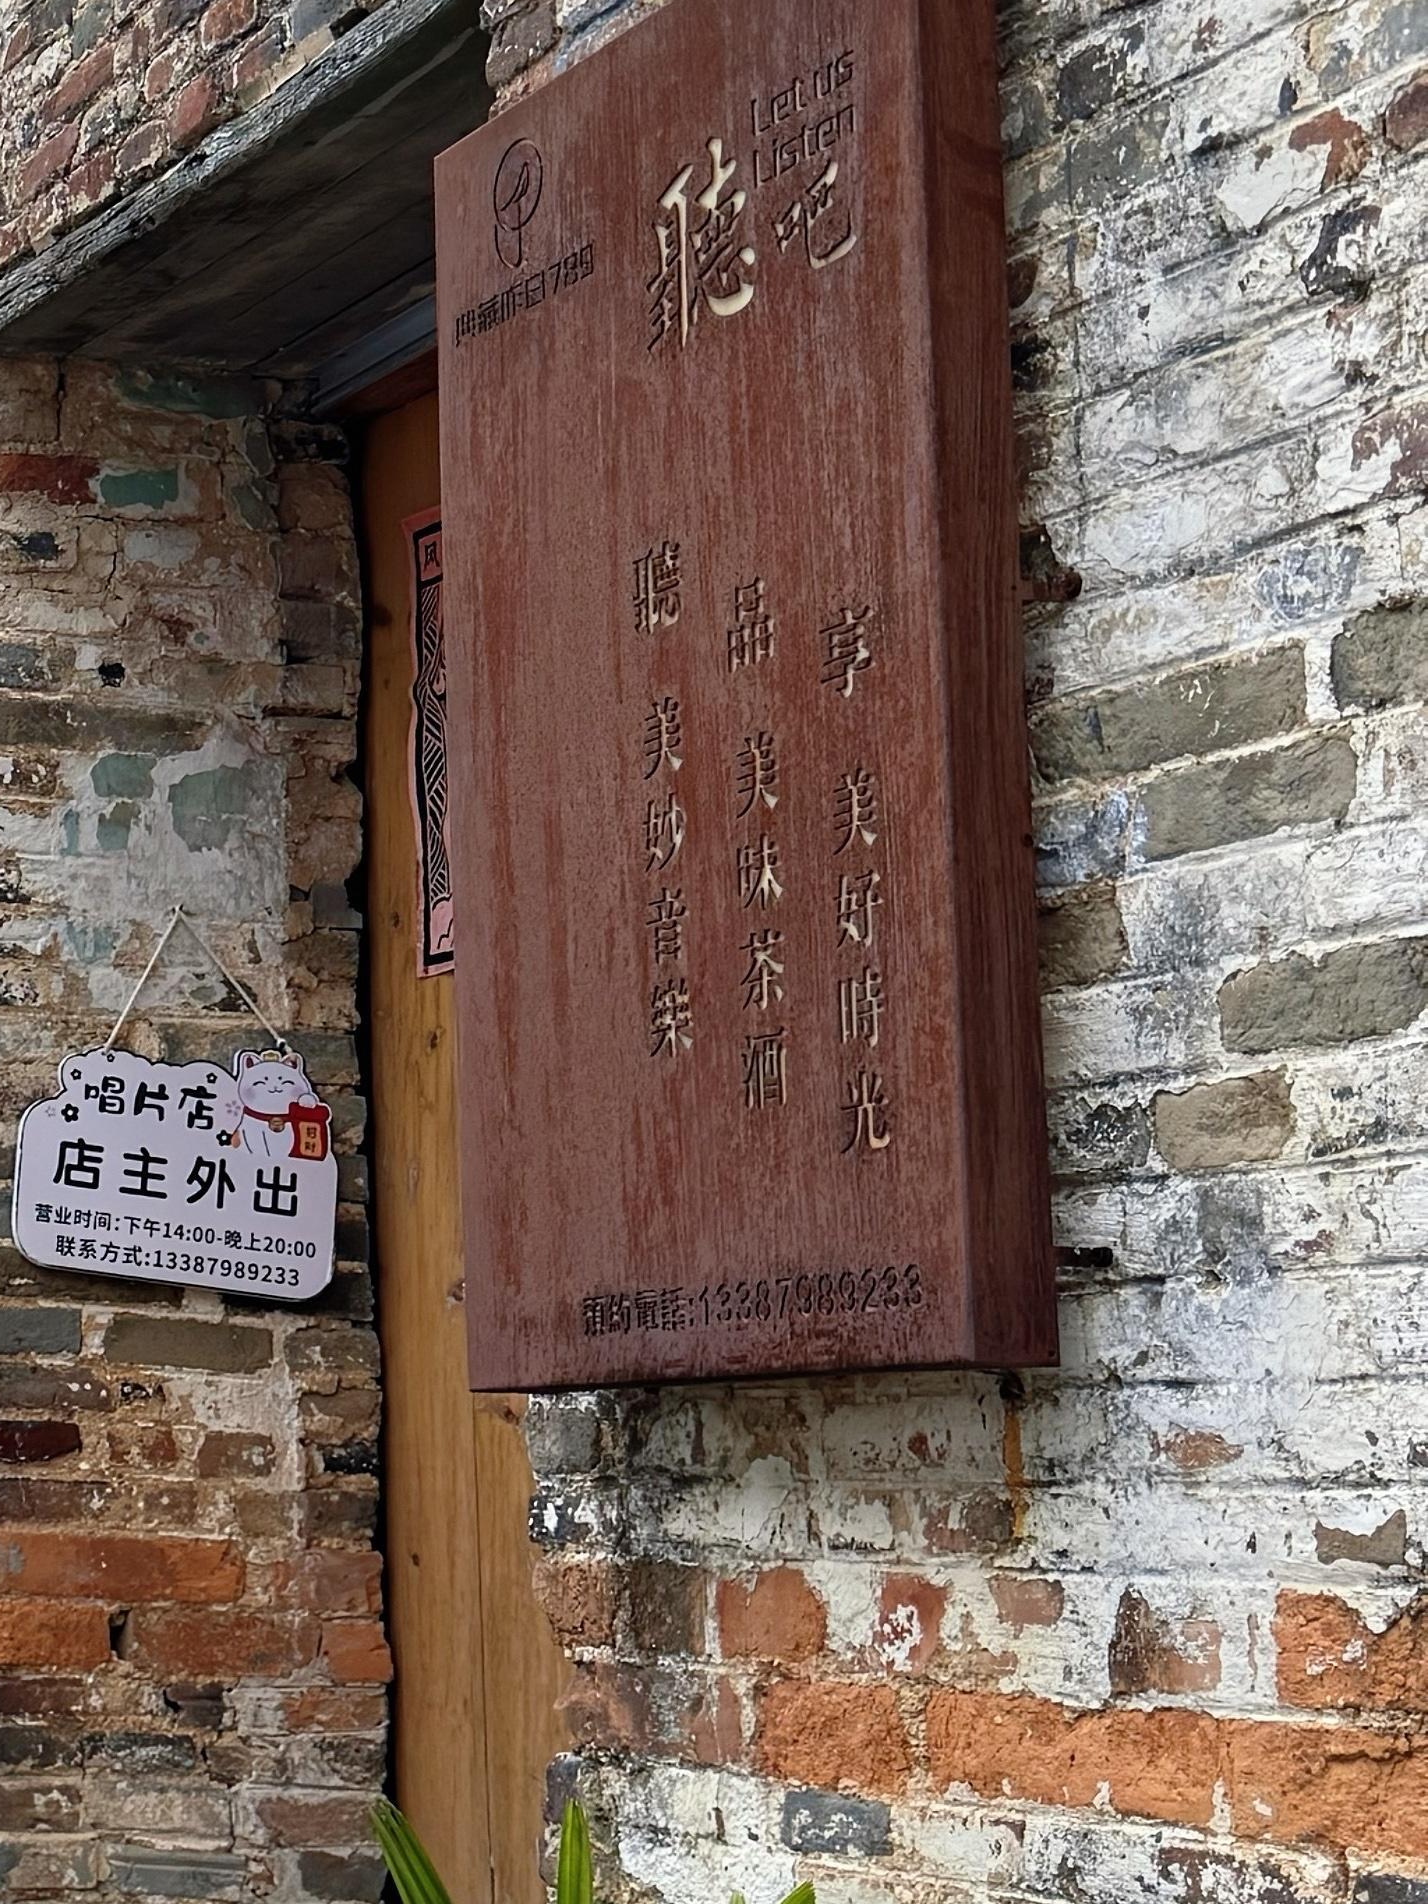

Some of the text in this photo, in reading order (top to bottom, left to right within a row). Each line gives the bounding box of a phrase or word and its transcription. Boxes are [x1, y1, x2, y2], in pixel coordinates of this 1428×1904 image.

[751, 49, 855, 136] Let us
[753, 104, 855, 189] Listen
[85, 1075, 217, 1130] 唱片店
[52, 1138, 298, 1217] 店主外出
